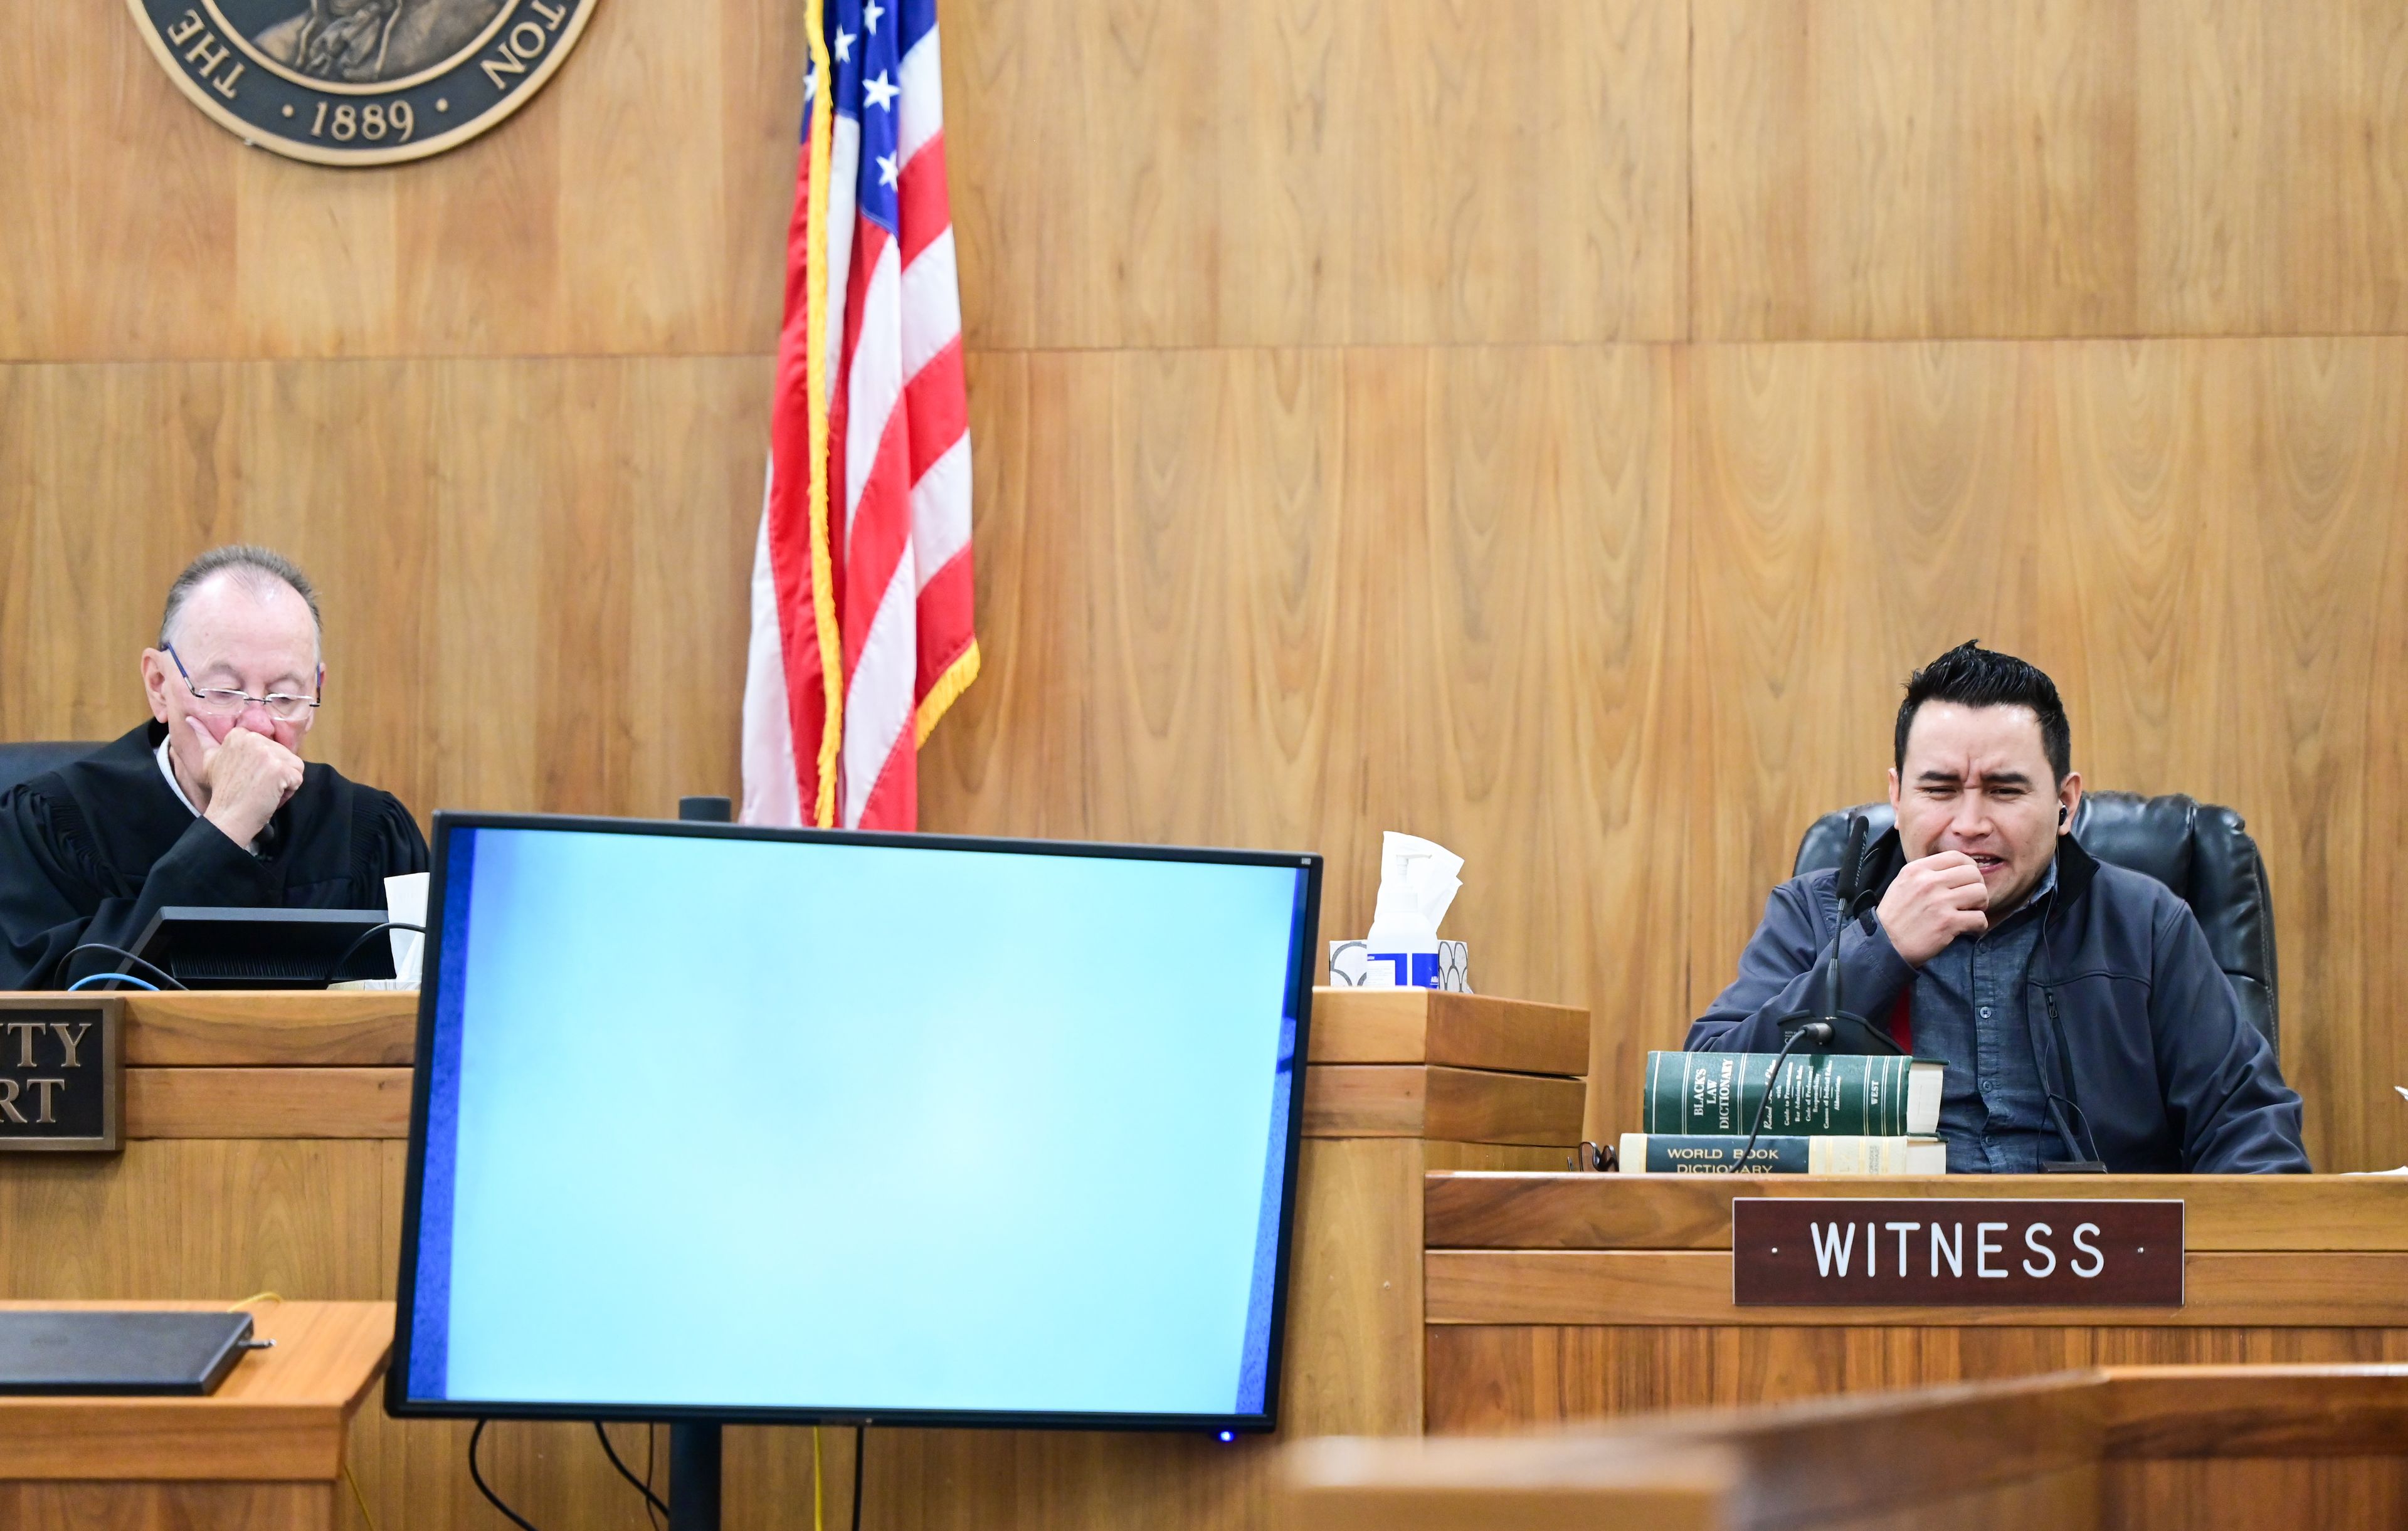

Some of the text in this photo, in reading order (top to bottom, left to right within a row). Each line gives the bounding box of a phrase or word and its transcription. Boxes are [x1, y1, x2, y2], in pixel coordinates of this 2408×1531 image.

[167, 9, 245, 99] THE
[310, 100, 415, 142] 1889
[0, 1023, 92, 1067] TY
[1706, 1079, 1717, 1104] LAW
[1719, 1058, 1733, 1129] DICTIONARY
[1871, 1080, 1879, 1105] WEST
[1667, 1149, 1723, 1159] WORLD
[1810, 1222, 2104, 1278] WITNESS
